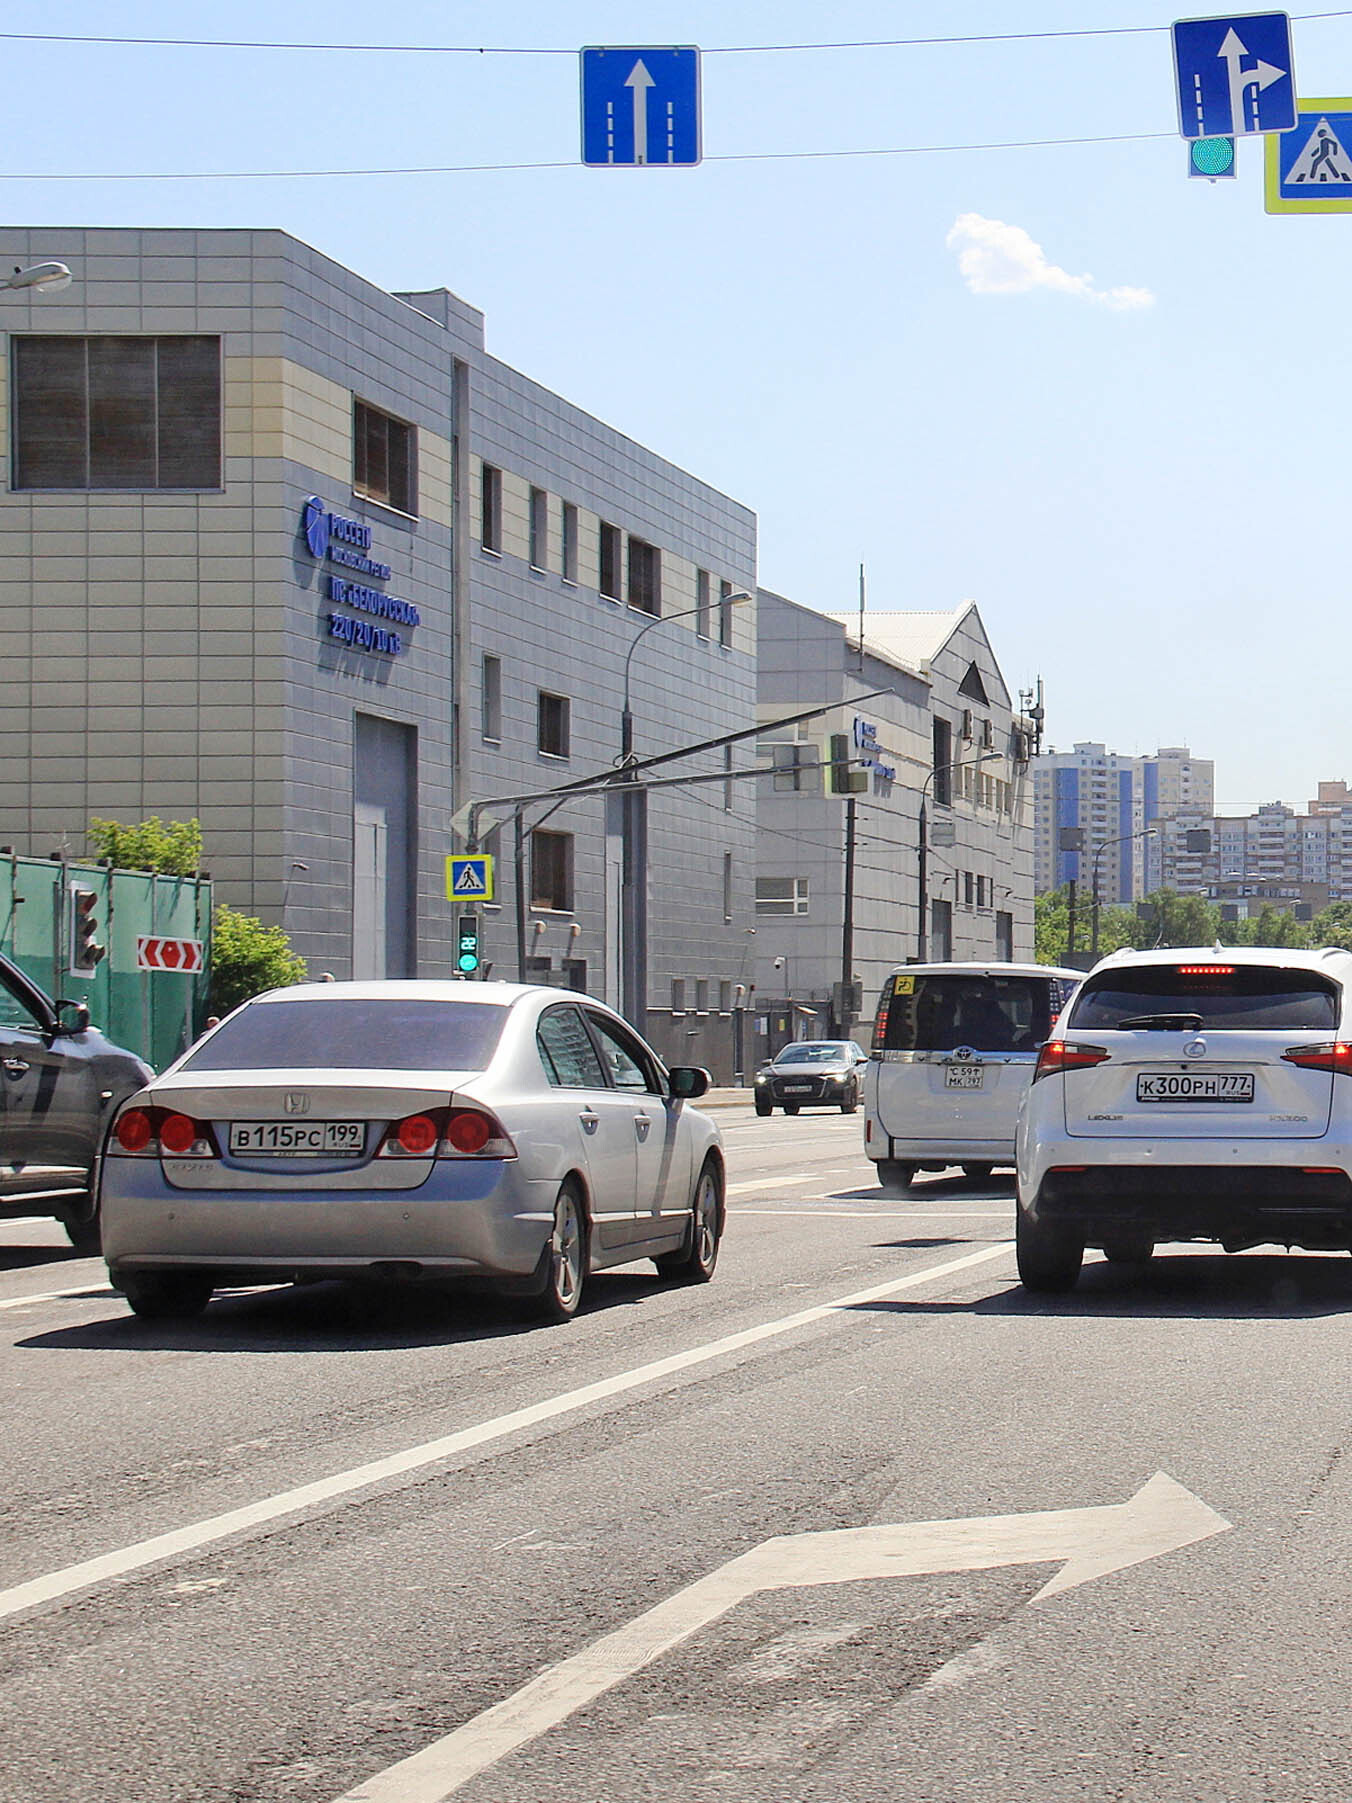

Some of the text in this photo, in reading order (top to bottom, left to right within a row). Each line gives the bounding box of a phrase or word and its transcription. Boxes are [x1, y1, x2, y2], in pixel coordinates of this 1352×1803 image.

[331, 513, 372, 549] РОССЕТИ
[1143, 1076, 1248, 1095] К300РН 777
[237, 1125, 359, 1147] В115РС 199
